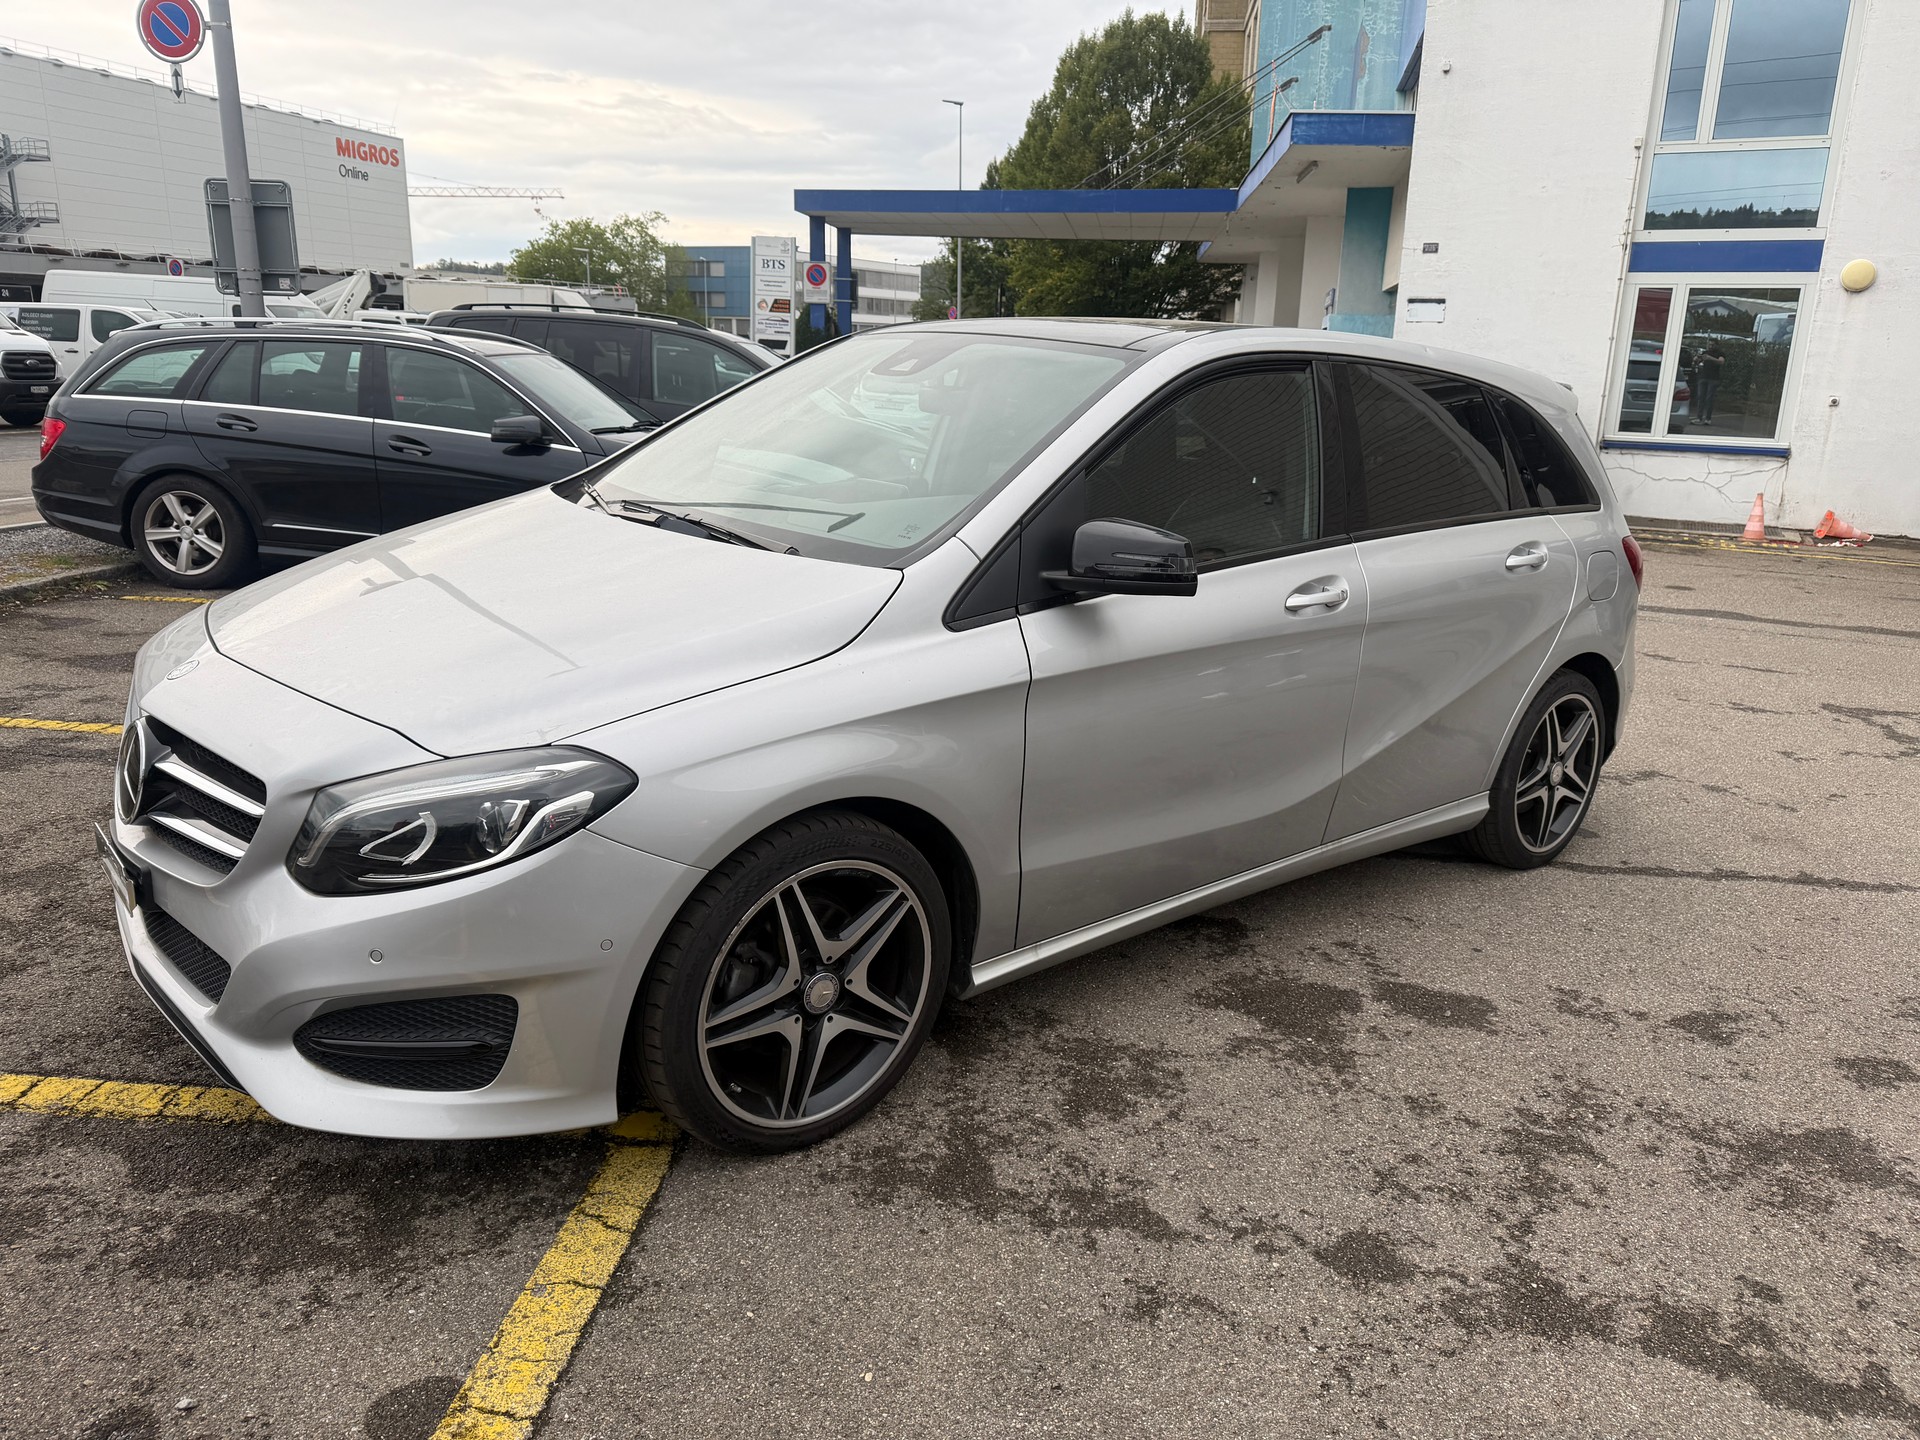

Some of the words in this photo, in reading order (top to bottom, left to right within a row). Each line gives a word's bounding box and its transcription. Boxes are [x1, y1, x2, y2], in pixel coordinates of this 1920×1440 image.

[336, 137, 399, 167] MIGROS
[339, 164, 368, 181] Online
[762, 258, 785, 270] BTS
[1, 288, 9, 297] 24
